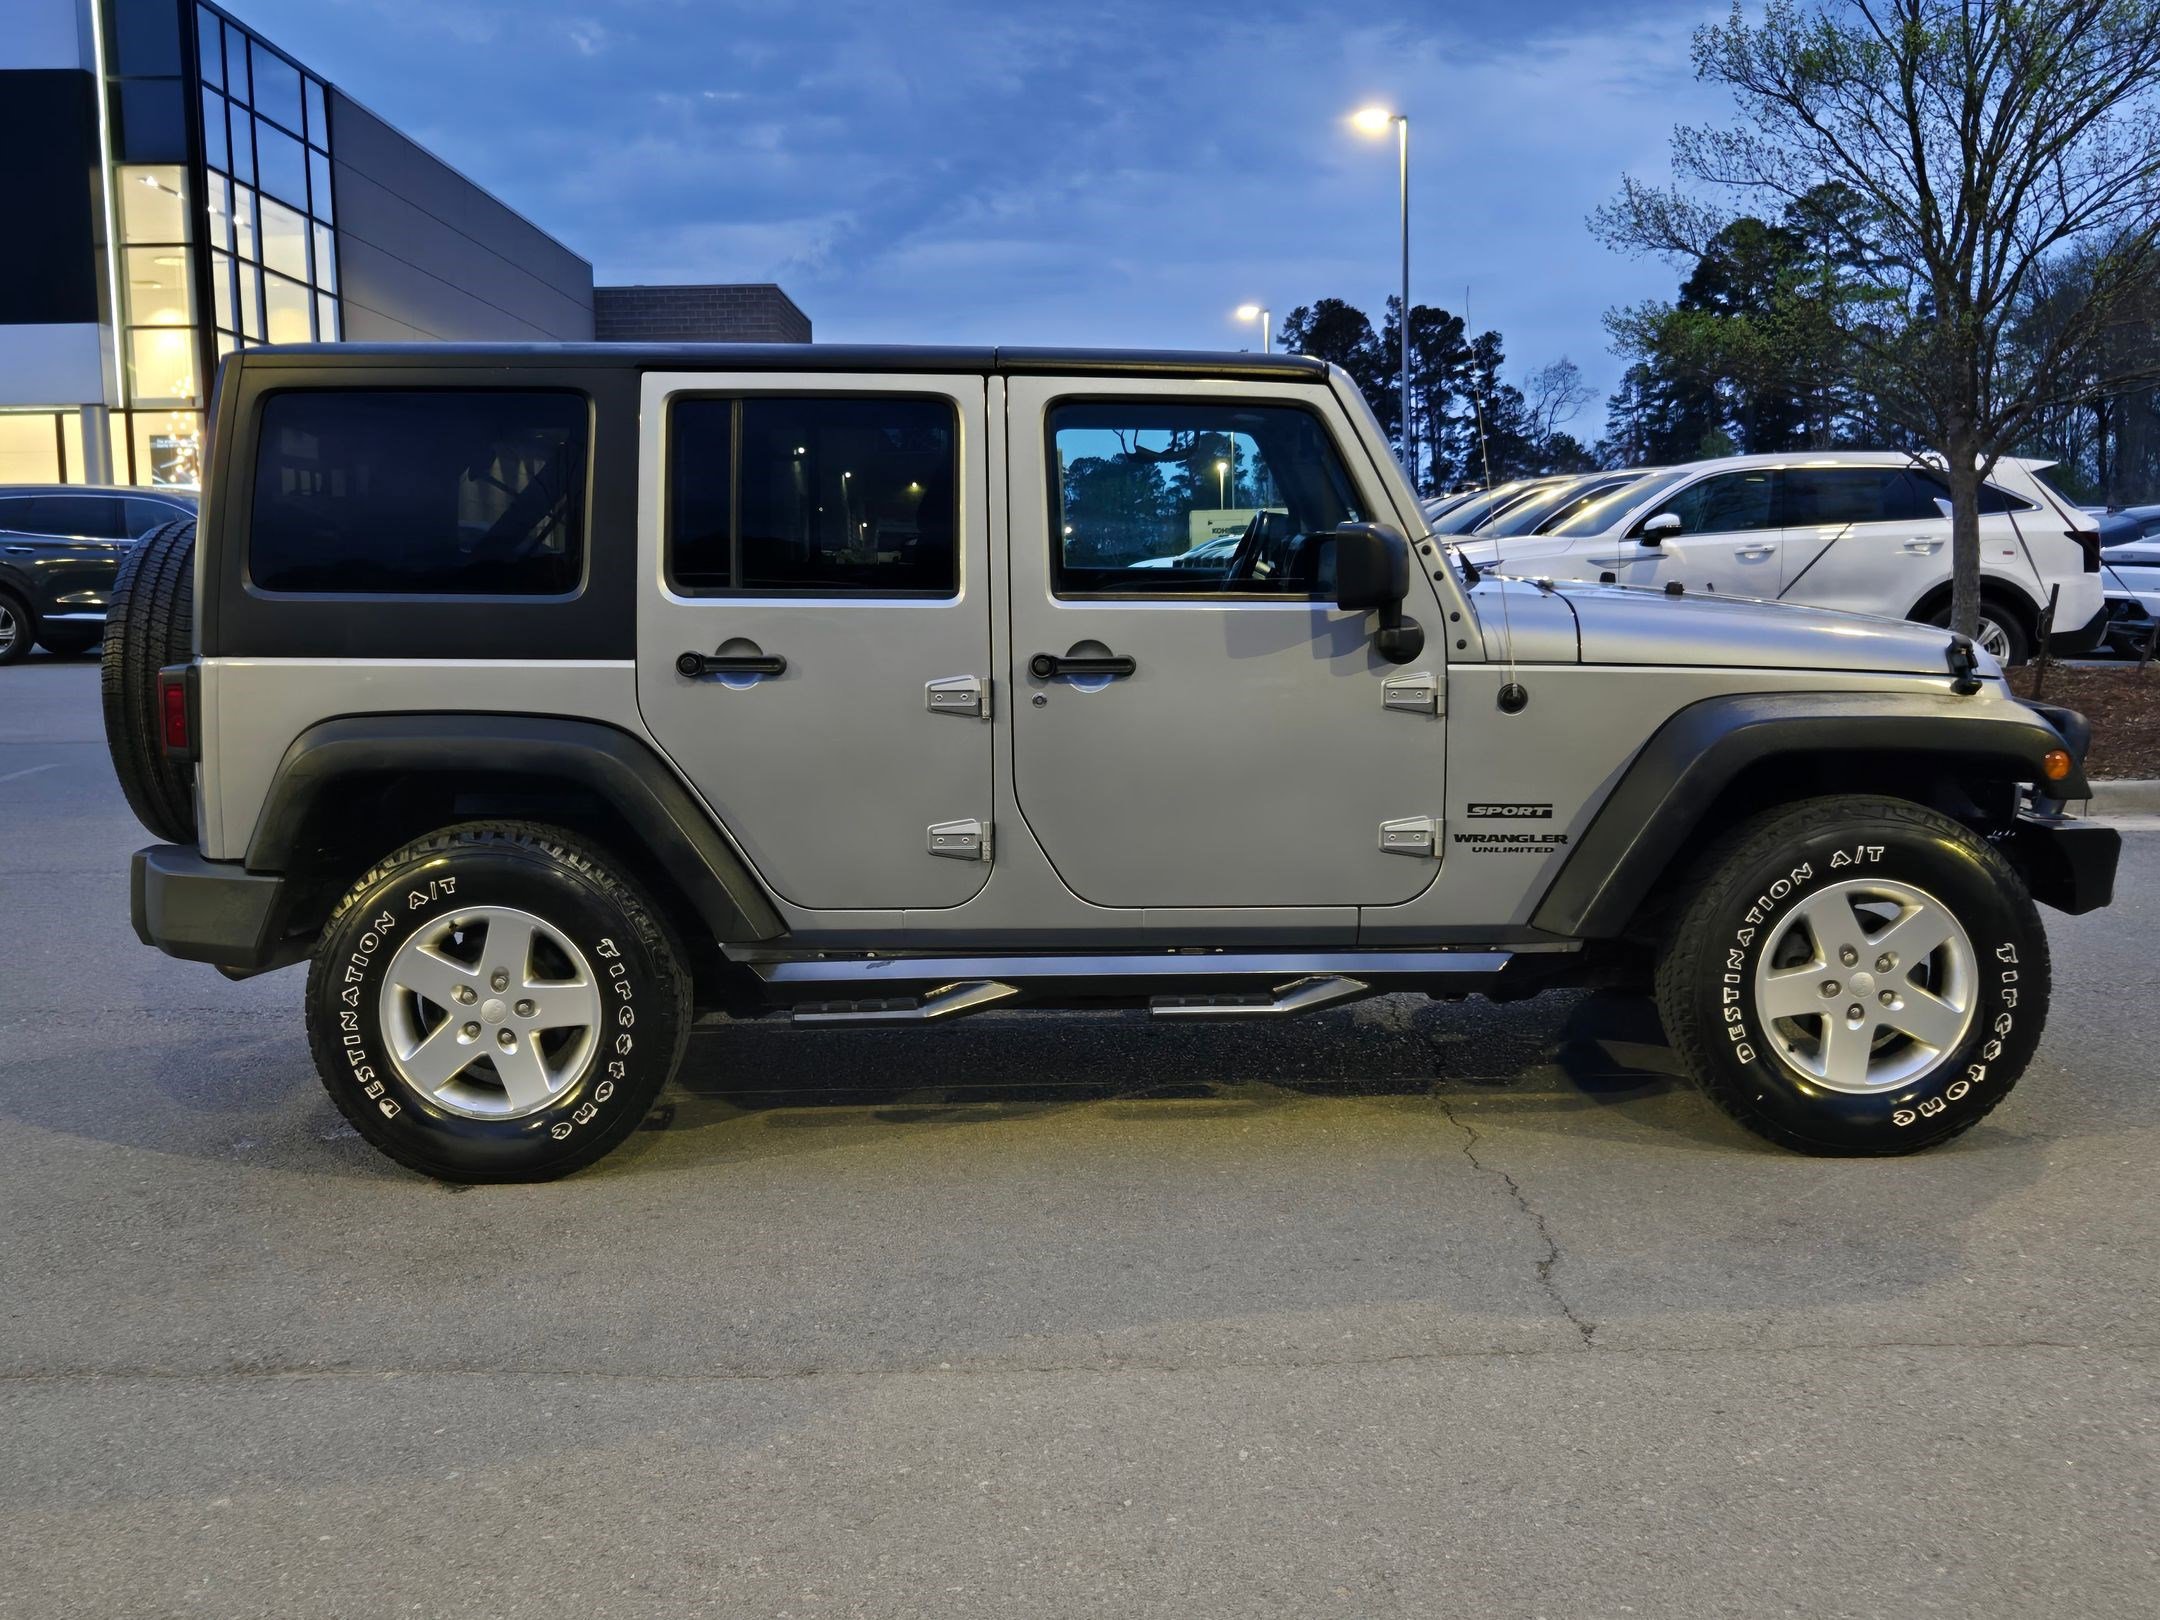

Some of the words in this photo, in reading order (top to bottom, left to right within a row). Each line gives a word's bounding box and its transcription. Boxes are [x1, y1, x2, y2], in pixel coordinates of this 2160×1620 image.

[1468, 805, 1552, 817] SPORT
[1453, 833, 1569, 844] WRANGLER
[1471, 846, 1555, 854] UNLIMITED
[1723, 862, 1813, 1064] DESTINATION
[1830, 845, 1885, 868] A/T
[340, 911, 401, 1119] DESTINATION
[408, 877, 456, 910] A/T
